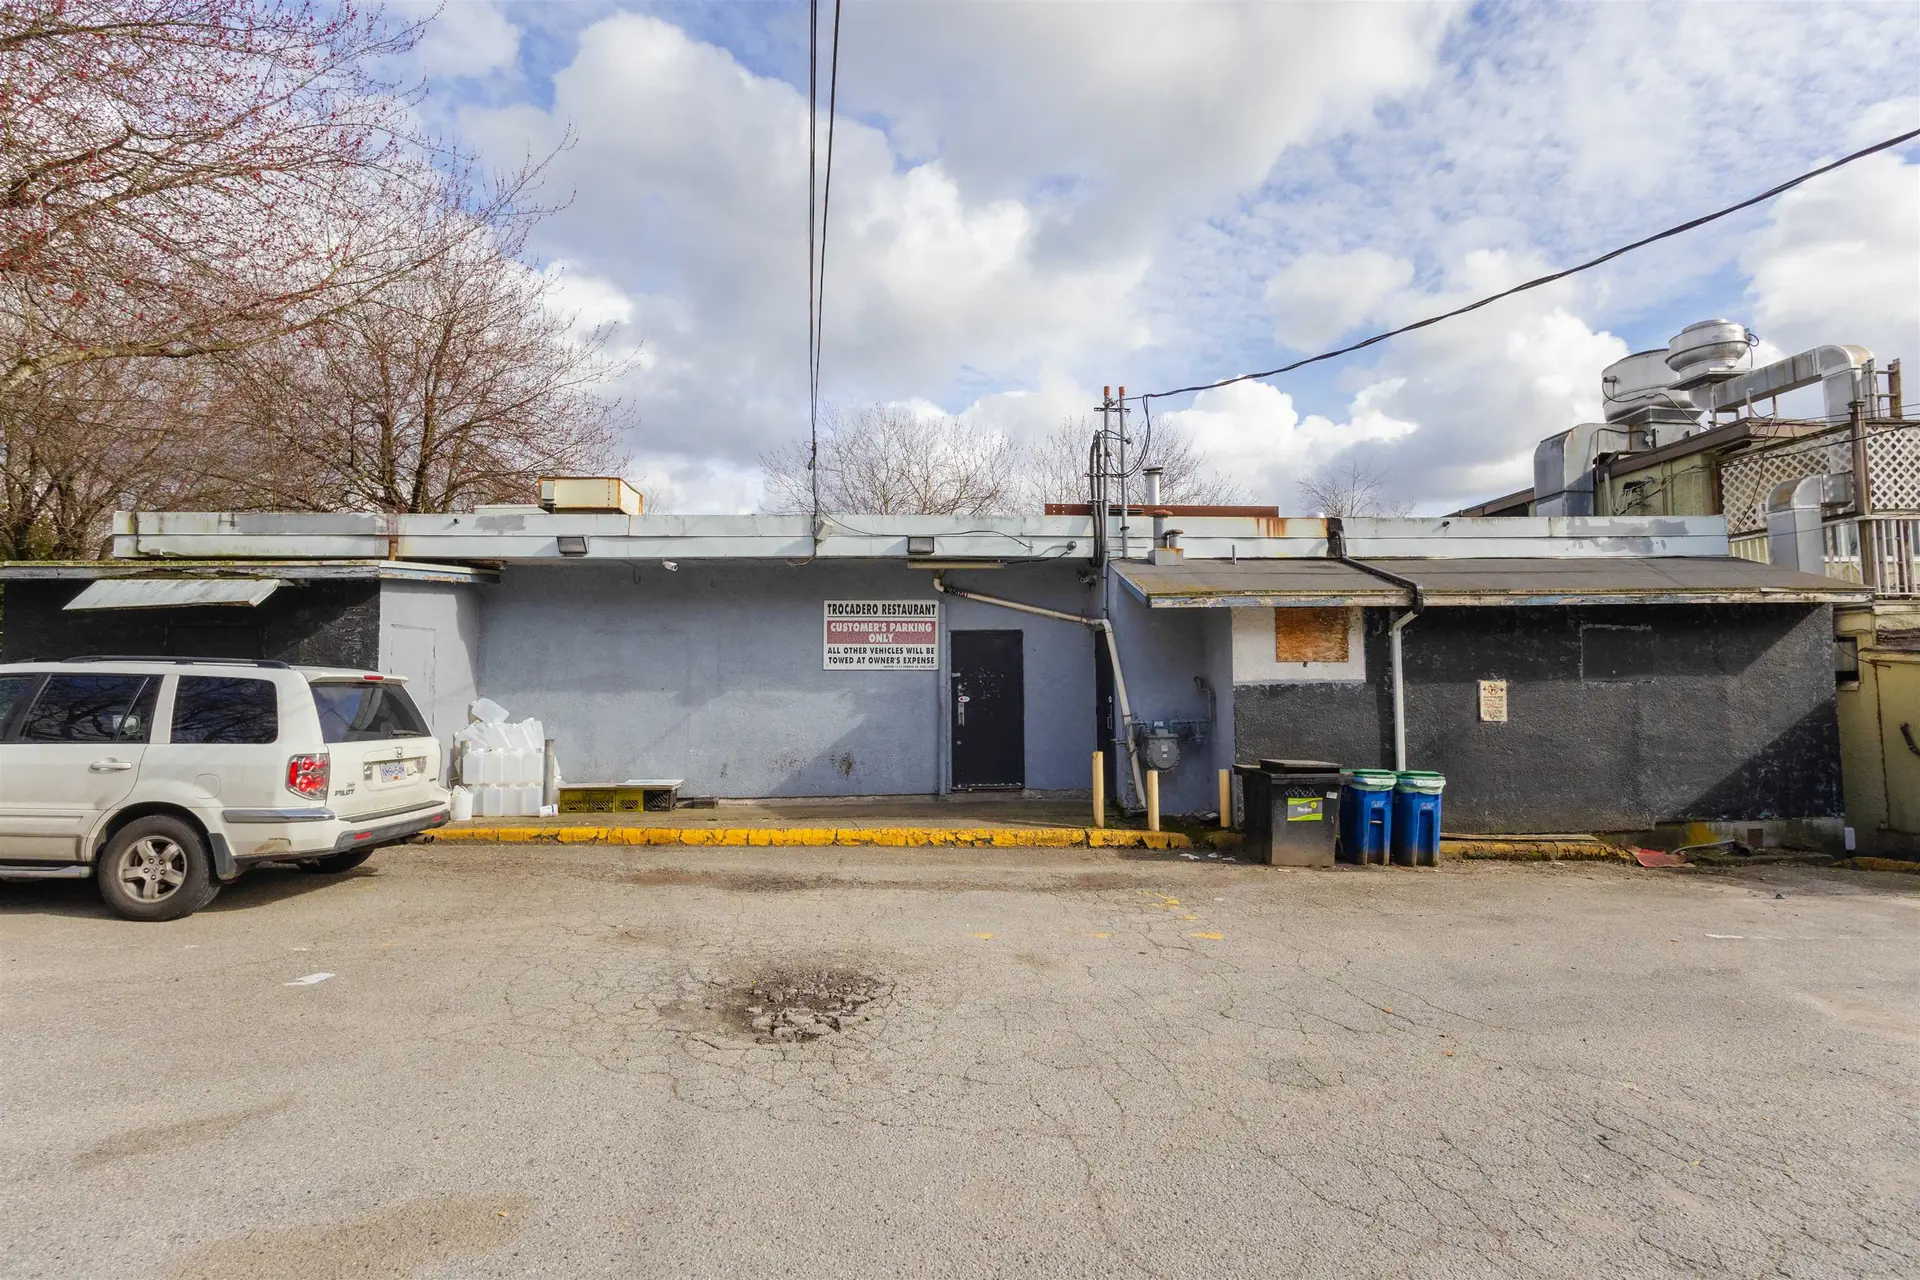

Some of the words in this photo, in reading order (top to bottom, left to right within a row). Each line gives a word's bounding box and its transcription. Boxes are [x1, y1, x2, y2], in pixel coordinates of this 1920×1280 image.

[827, 603, 879, 616] TROCADERO
[881, 603, 936, 616] RESTAURANT
[830, 622, 887, 632] CUSTOMER'S
[889, 622, 933, 632] PARKING
[868, 633, 895, 643] ONLY
[827, 647, 841, 655] ALL
[843, 647, 867, 655] OTHER
[869, 647, 904, 655] VEHICLES
[905, 647, 923, 655] WILL
[926, 647, 935, 655] BE
[828, 656, 854, 664] TOWED
[856, 656, 866, 664] AT
[868, 656, 901, 664] OWNER'S
[903, 656, 935, 664] EXPENSE
[334, 788, 356, 797] PILOT
